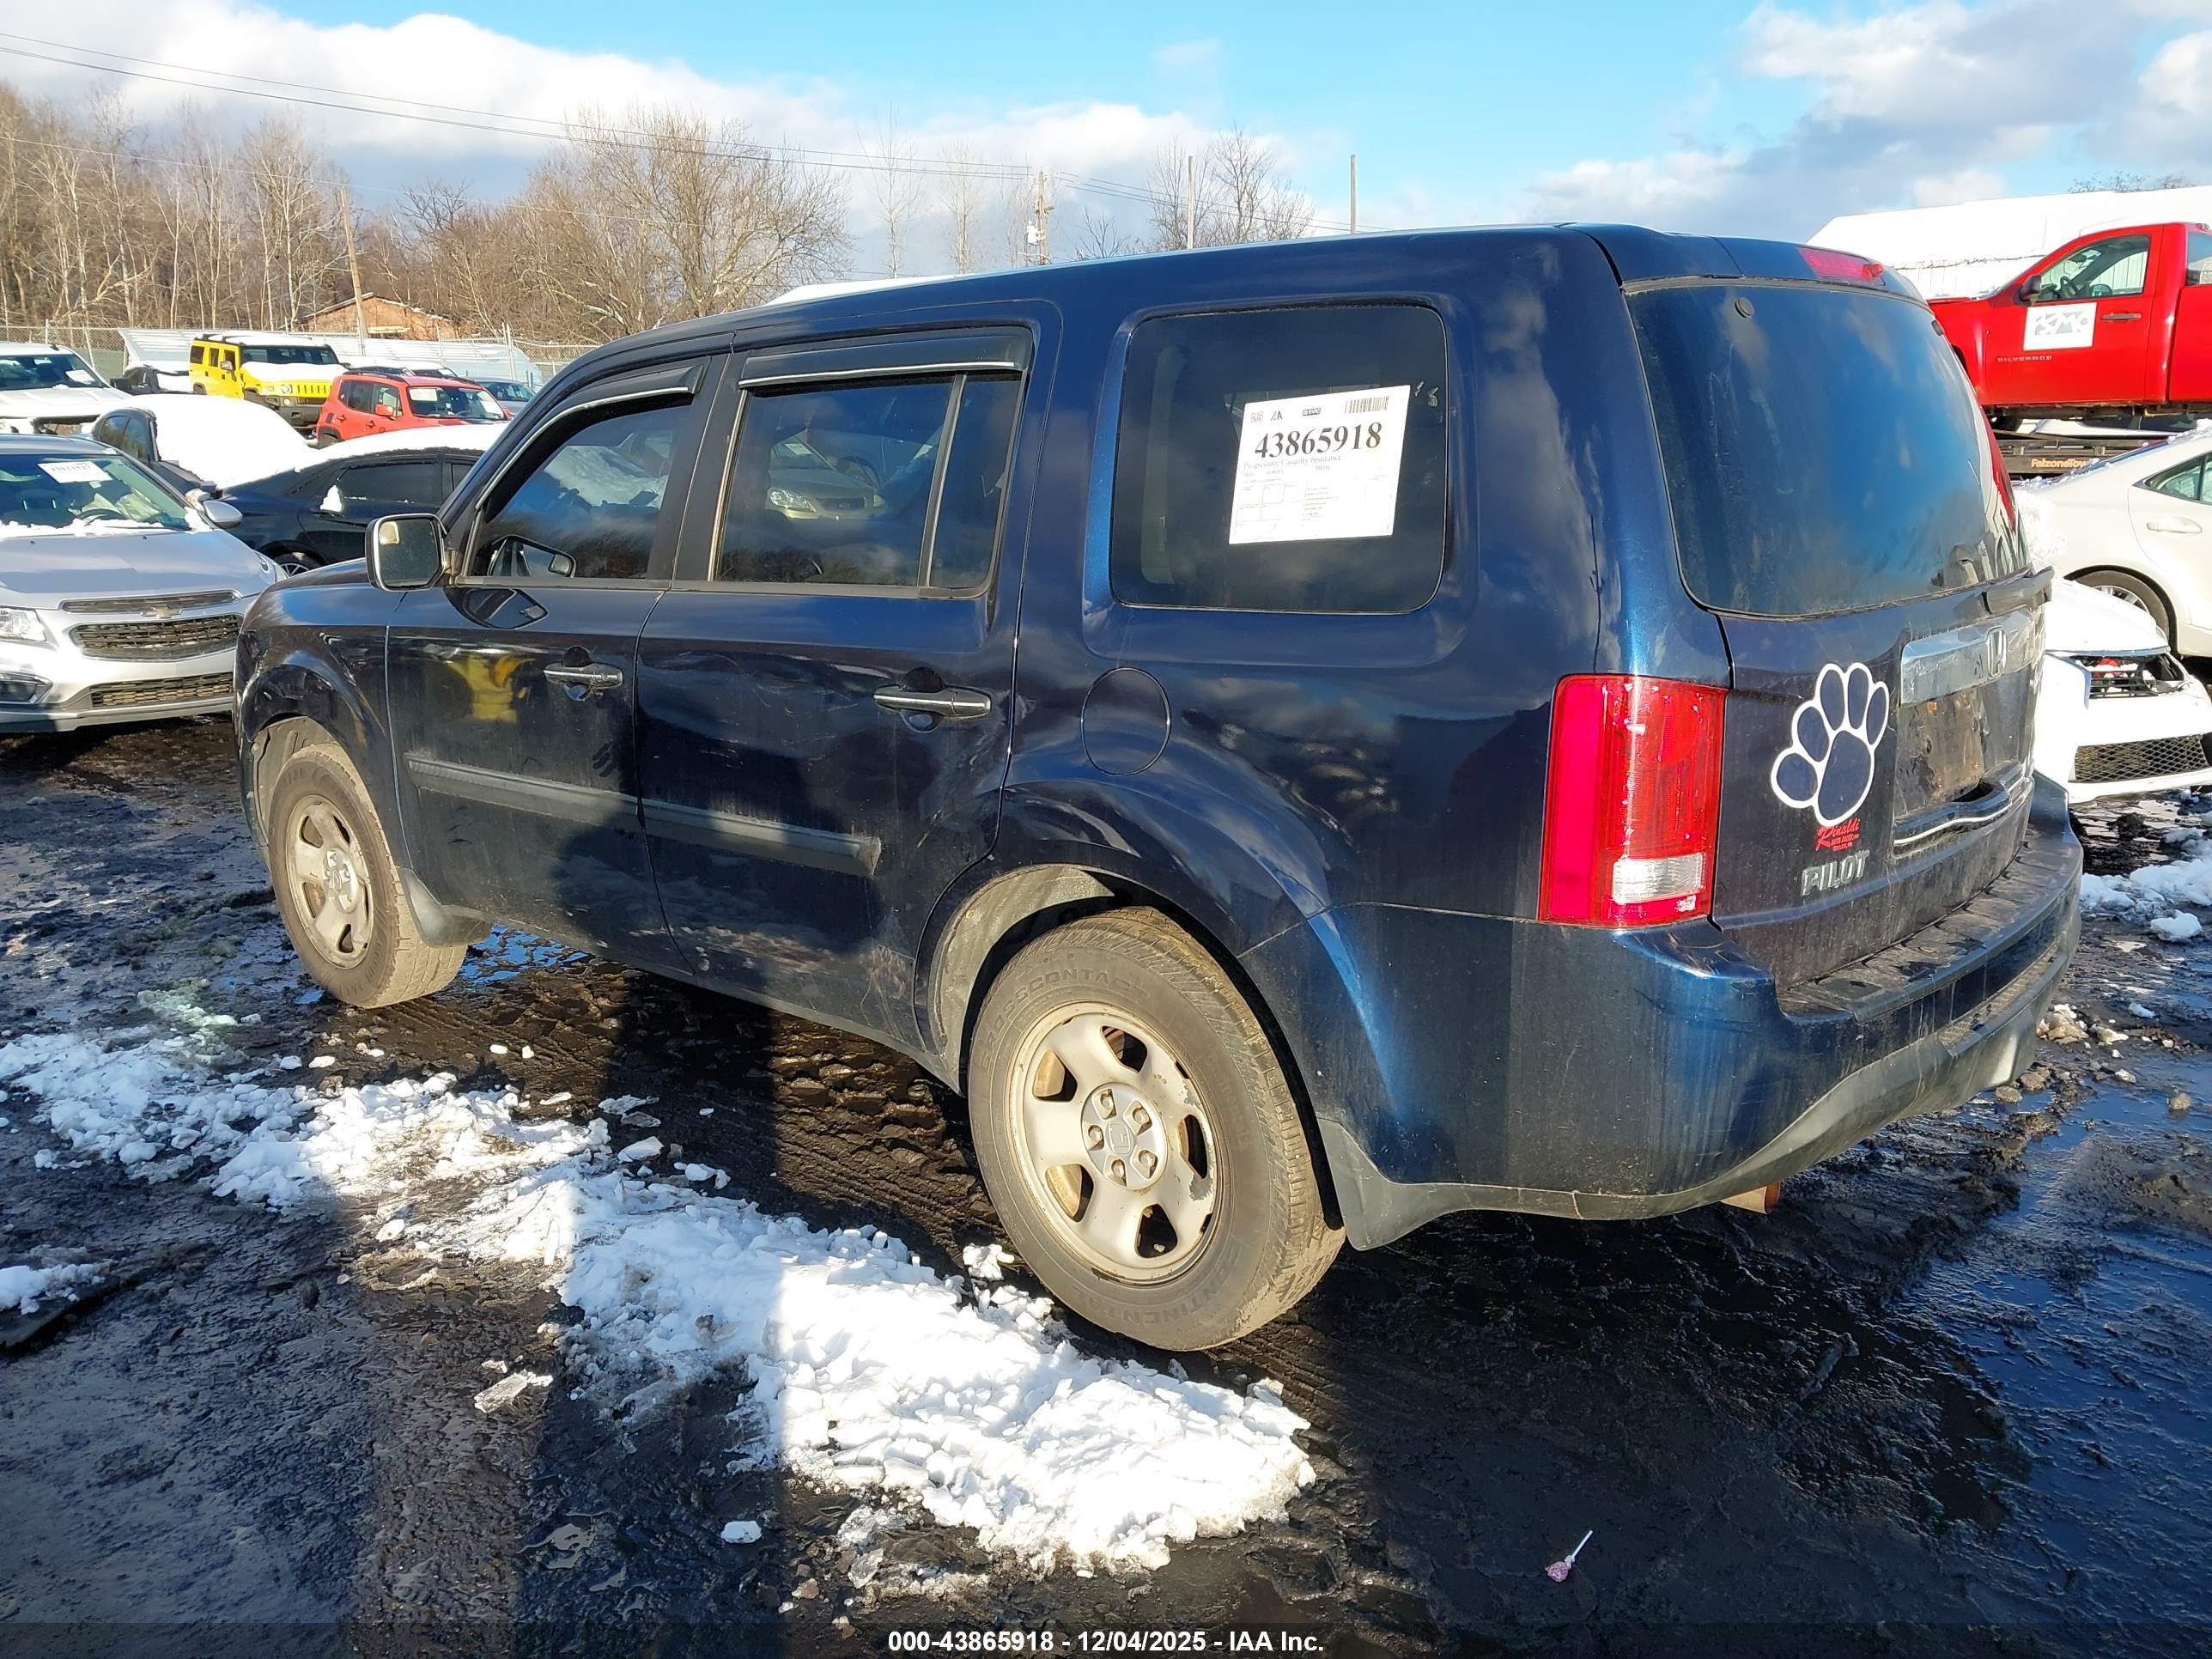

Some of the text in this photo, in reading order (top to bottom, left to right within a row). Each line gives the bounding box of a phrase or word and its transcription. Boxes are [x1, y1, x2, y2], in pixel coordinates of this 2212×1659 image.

[1255, 422, 1382, 458] 43865918
[1815, 817, 1861, 851] Rinaldi
[1802, 850, 1869, 895] PILOT
